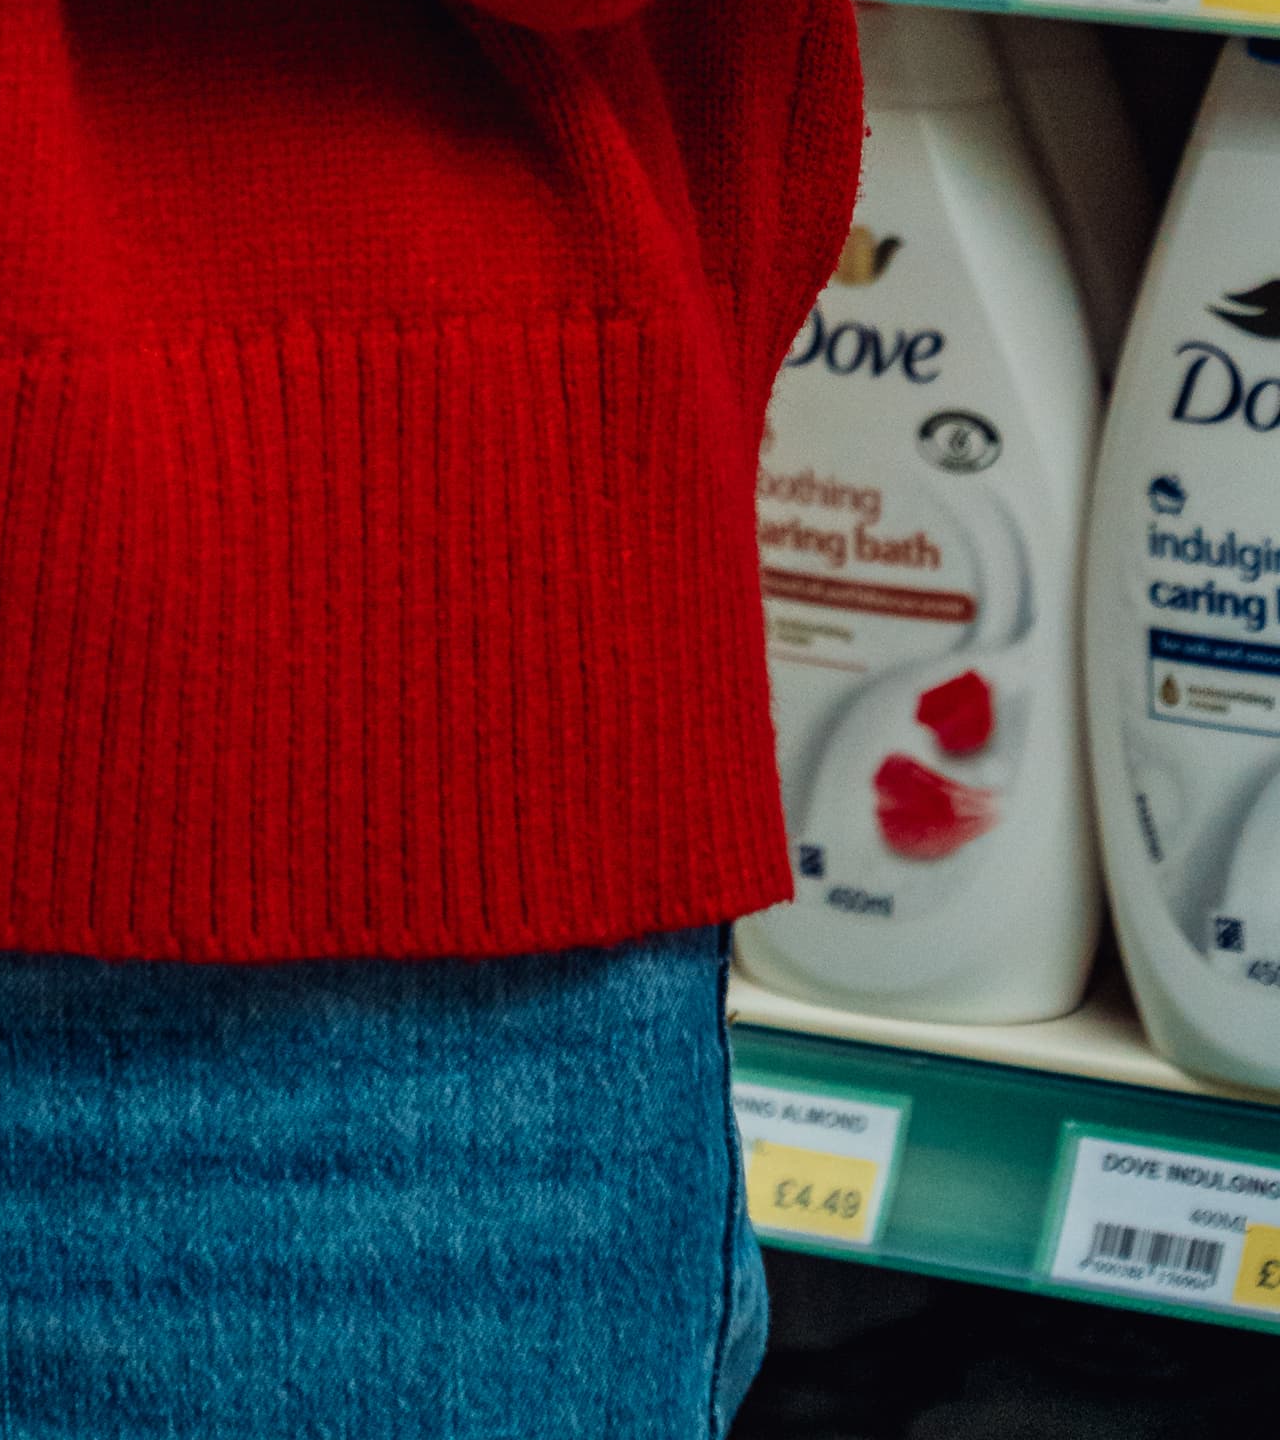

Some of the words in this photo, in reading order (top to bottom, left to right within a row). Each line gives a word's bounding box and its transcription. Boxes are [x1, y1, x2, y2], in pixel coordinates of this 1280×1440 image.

[853, 524, 942, 571] bath
[1149, 579, 1267, 633] caring
[780, 1102, 870, 1134] ALMOND
[1101, 1151, 1162, 1180] DOVE
[773, 1176, 863, 1220] £4.49
